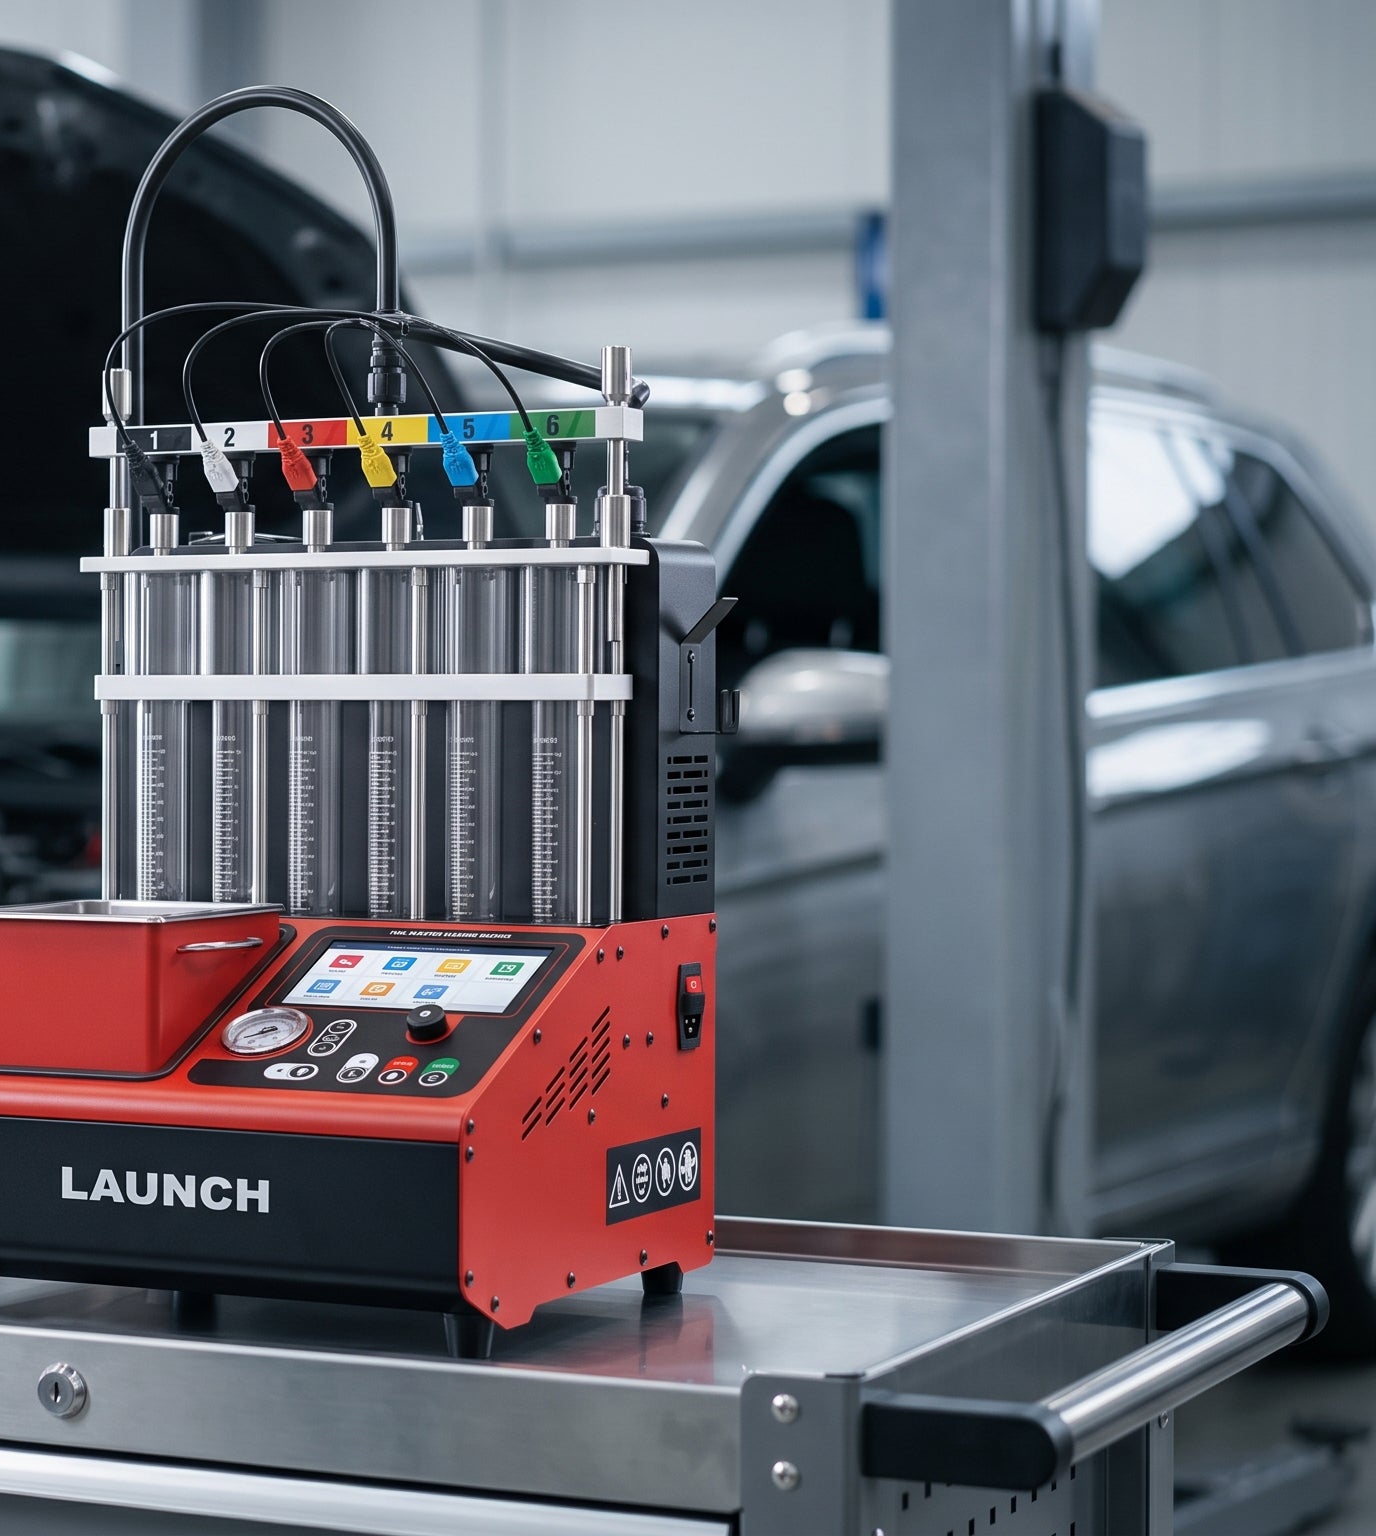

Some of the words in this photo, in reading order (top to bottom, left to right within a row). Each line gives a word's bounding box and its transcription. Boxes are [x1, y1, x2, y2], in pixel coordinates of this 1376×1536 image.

[150, 430, 158, 450] 1
[224, 427, 235, 447] 2
[301, 424, 314, 444] 3
[380, 421, 393, 441] 4
[463, 418, 474, 439] 5
[546, 414, 559, 436] 6
[61, 1166, 270, 1213] LAUNCH
